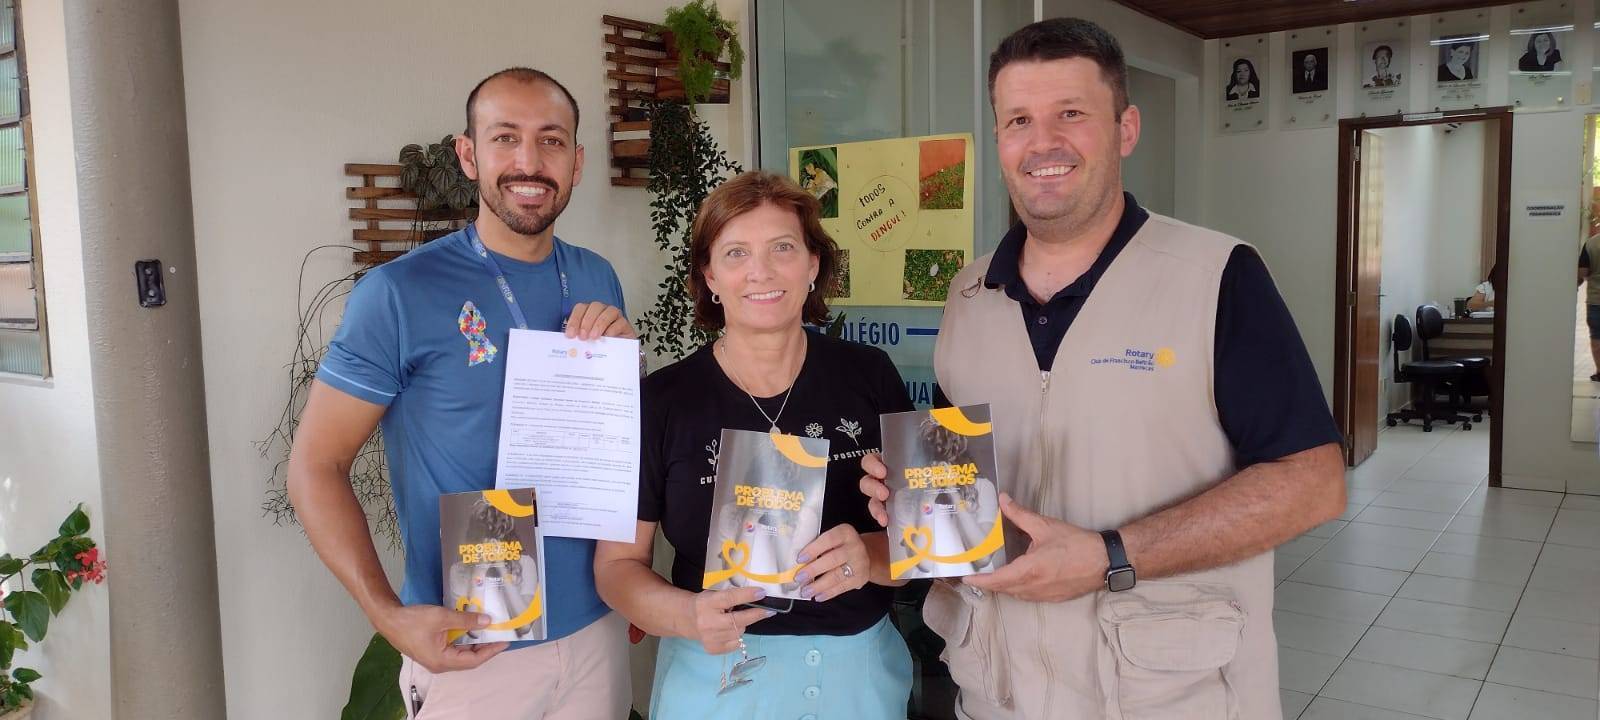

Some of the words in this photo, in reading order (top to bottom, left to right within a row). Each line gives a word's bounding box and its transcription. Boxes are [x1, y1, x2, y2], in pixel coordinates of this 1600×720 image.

[1126, 349, 1154, 359] Rotary
[904, 463, 979, 479] PROBLEMA
[908, 478, 929, 490] DE
[931, 473, 976, 488] TODOS
[735, 484, 805, 502] PROBLEMA
[736, 495, 755, 507] DE
[757, 495, 801, 511] TODOS
[459, 540, 523, 555] PROBLEMA
[462, 553, 480, 565] DE
[482, 549, 521, 562] TODOS
